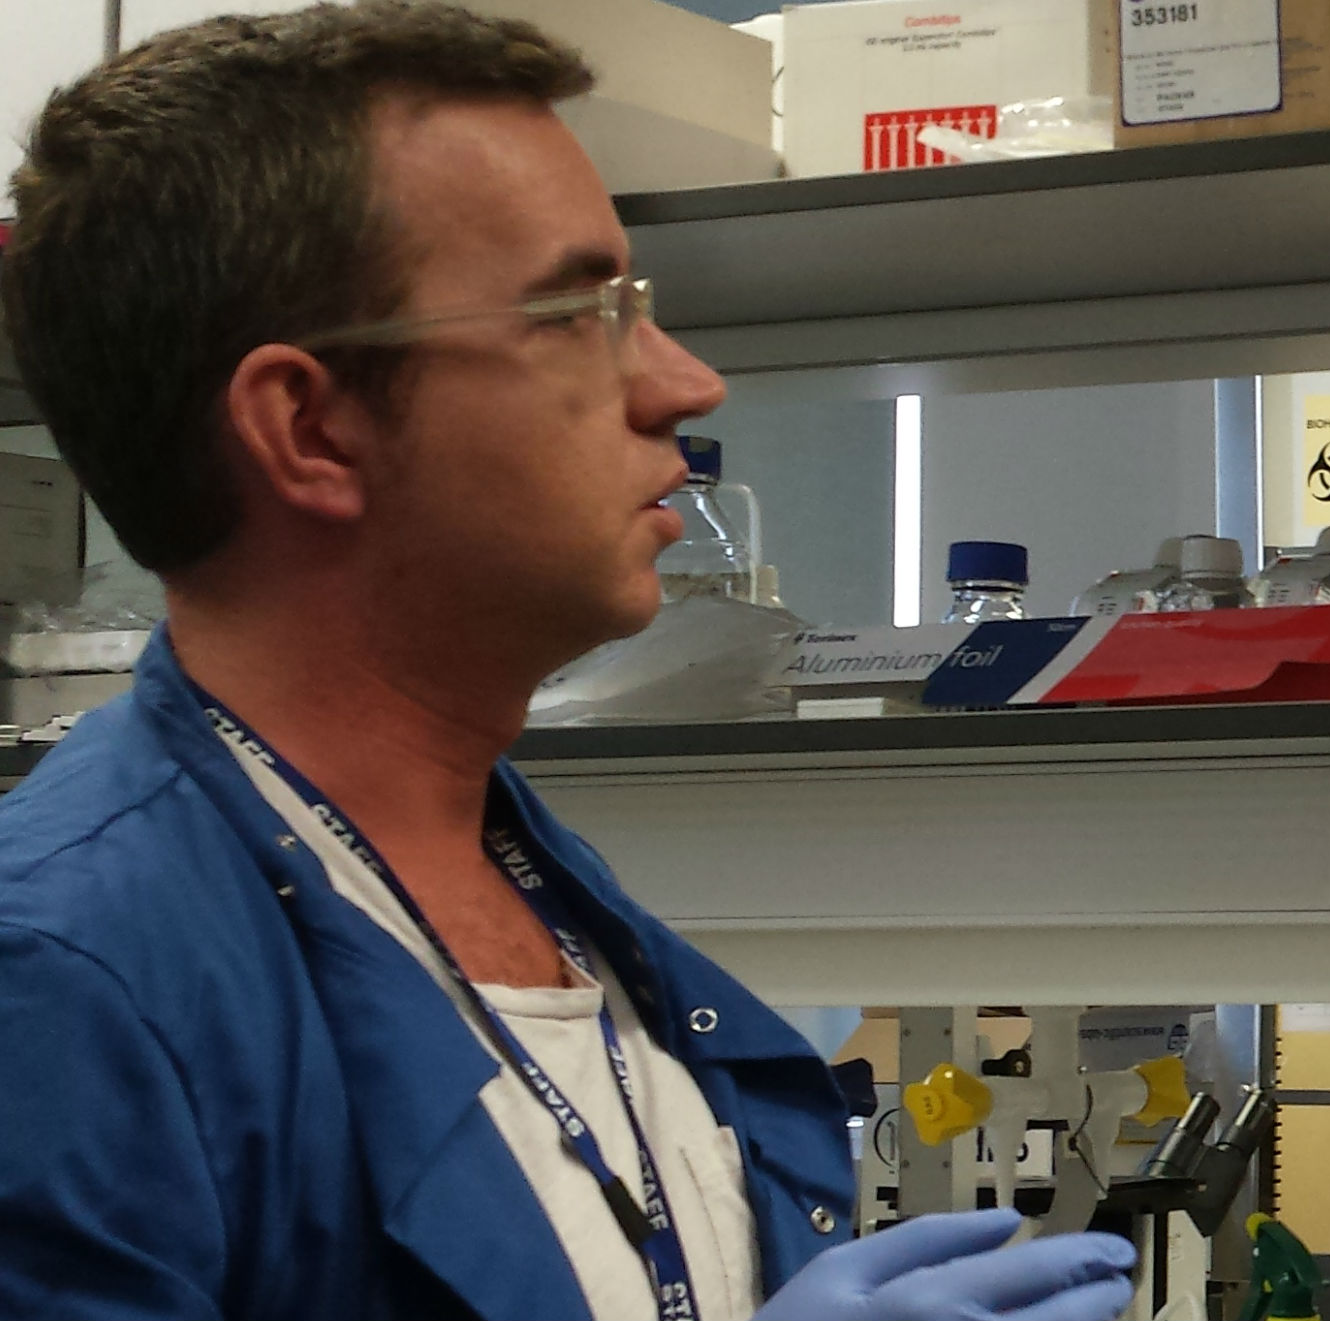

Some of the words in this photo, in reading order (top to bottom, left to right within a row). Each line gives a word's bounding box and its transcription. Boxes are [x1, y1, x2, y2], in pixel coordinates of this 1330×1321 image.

[1131, 4, 1199, 27] 353181
[783, 651, 943, 675] Aluminium
[950, 645, 1004, 668] foil
[521, 1061, 586, 1138] STAFF
